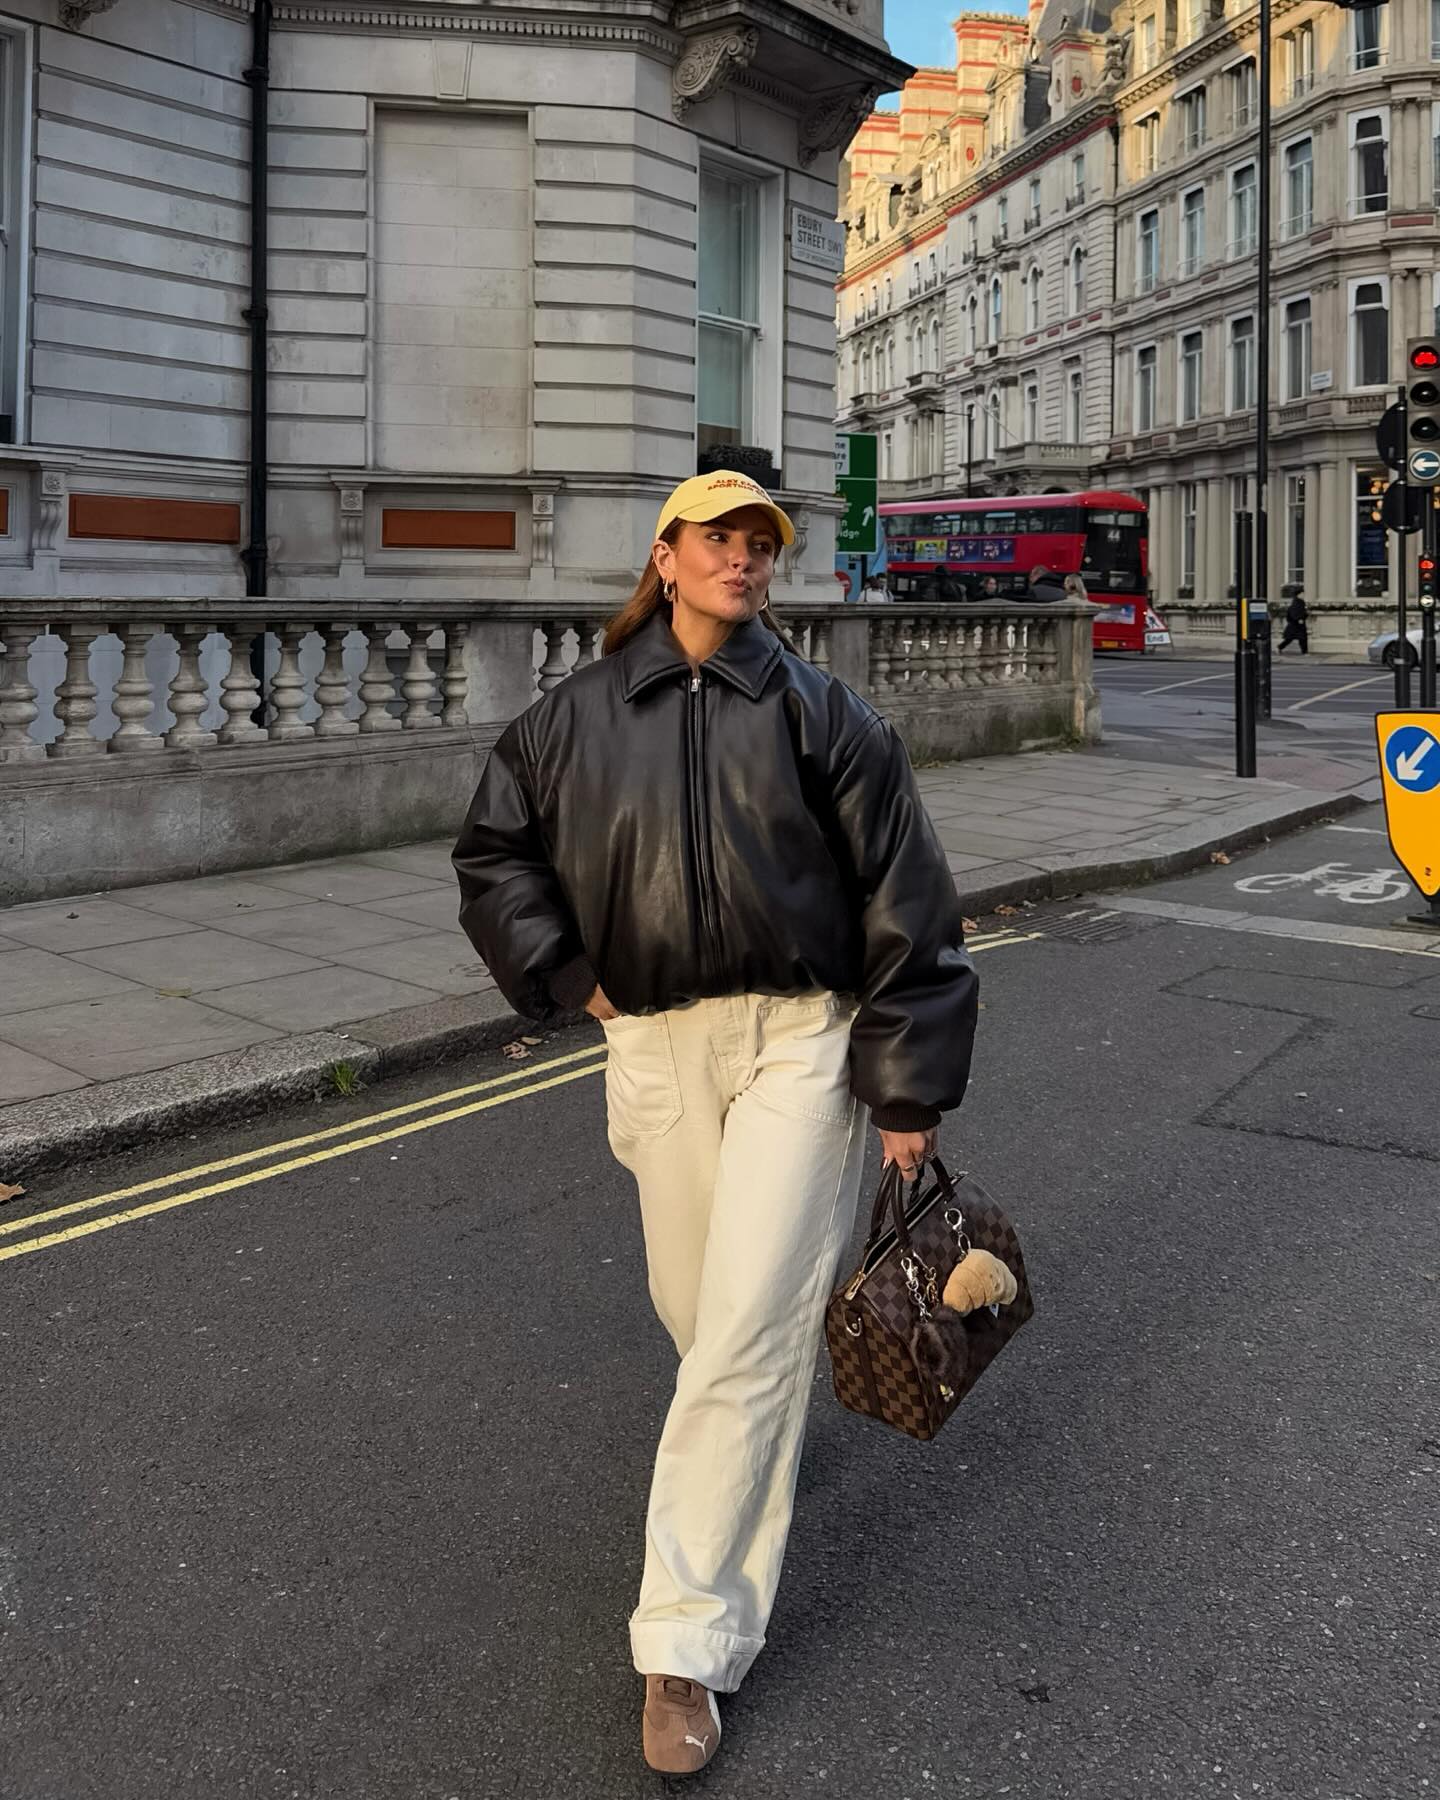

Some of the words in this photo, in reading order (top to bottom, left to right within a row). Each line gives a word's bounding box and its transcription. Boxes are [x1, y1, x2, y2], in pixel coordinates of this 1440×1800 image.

[797, 214, 823, 233] EBURY
[797, 230, 826, 250] STREET
[840, 529, 860, 540] idge
[1107, 529, 1120, 541] 44
[1147, 634, 1164, 643] End
